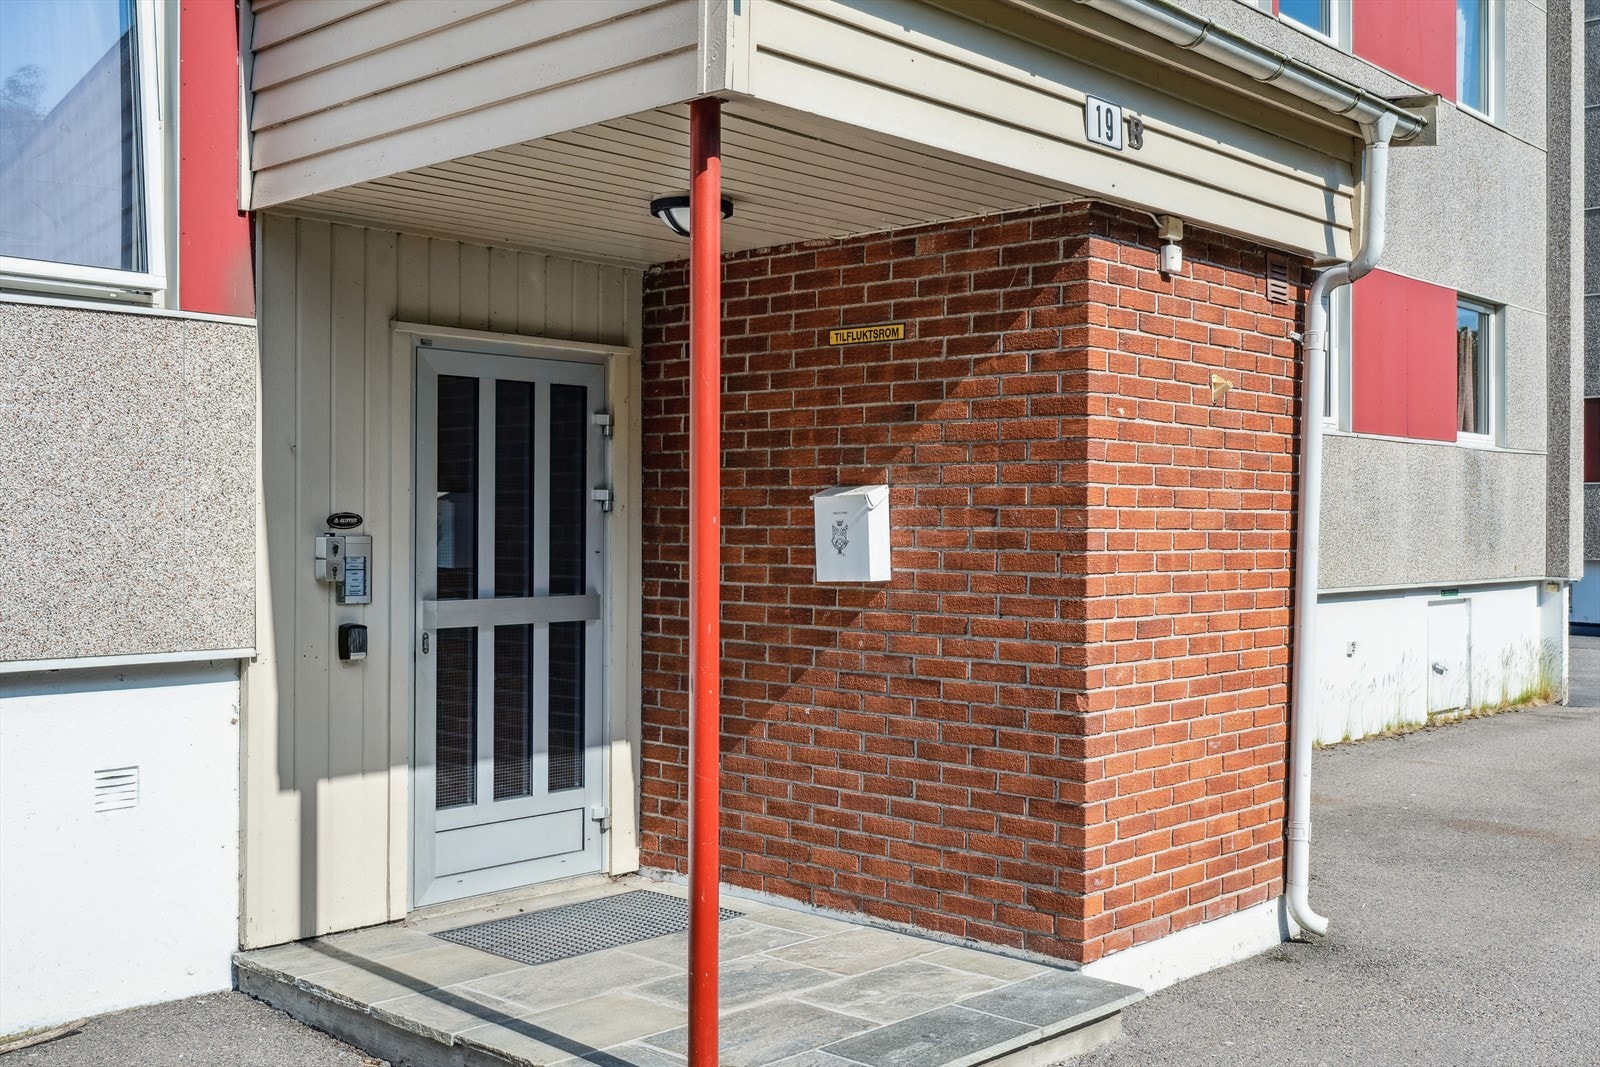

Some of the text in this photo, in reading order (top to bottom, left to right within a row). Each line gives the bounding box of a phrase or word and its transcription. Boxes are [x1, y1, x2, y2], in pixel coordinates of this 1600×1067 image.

[1096, 105, 1144, 151] 19 B
[834, 327, 900, 342] TILFLUKTSROM
